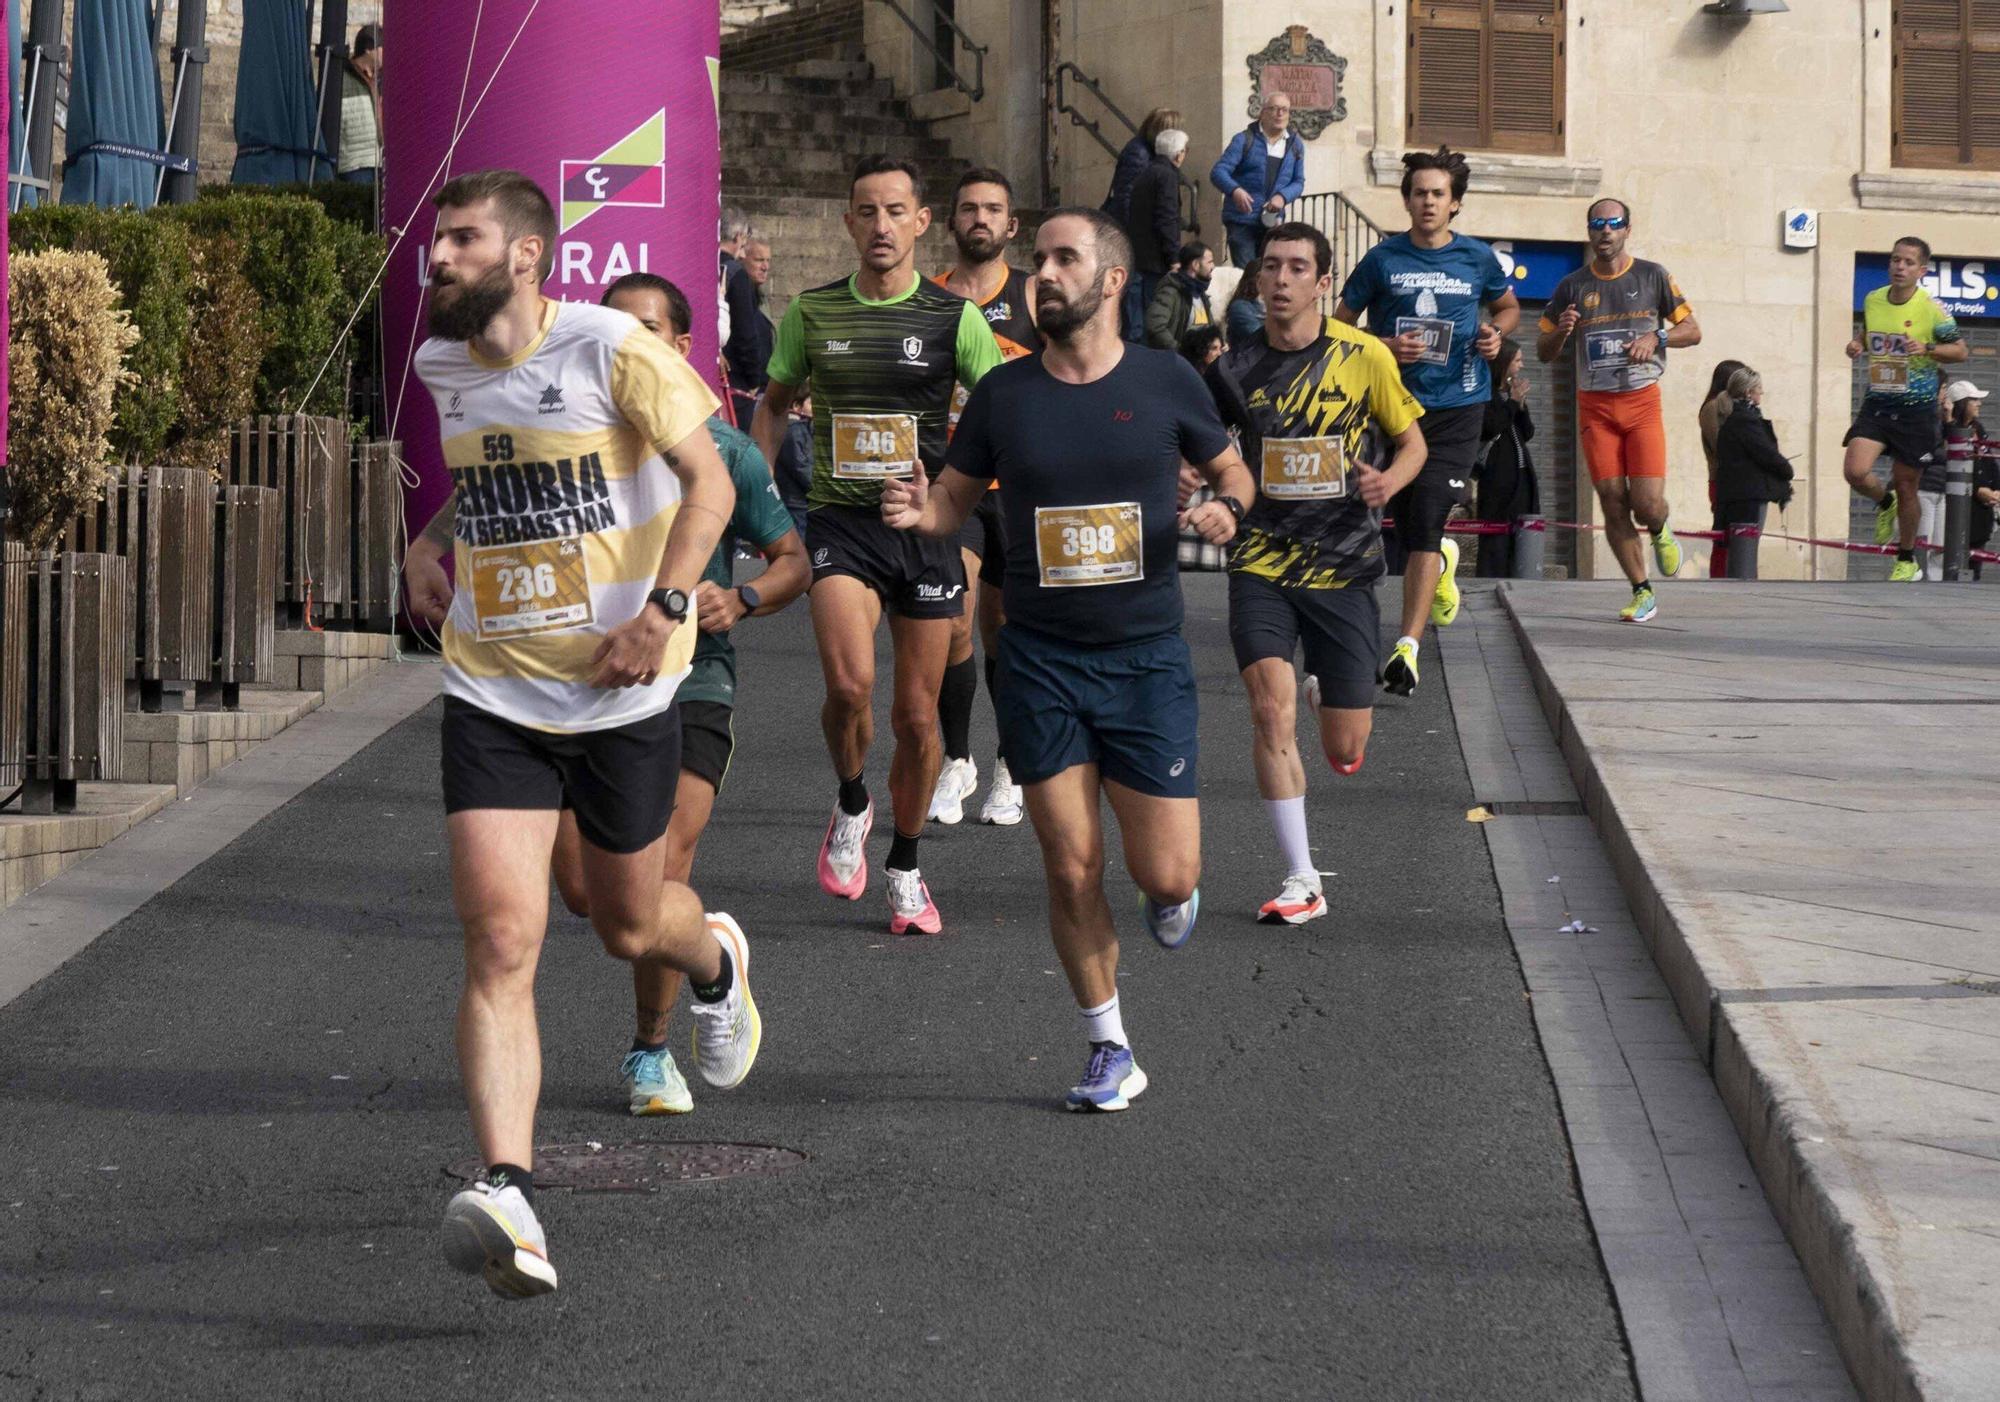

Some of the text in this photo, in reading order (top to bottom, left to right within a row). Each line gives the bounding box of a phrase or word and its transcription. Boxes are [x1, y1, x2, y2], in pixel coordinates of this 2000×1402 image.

[1954, 302, 1986, 315] People
[826, 340, 851, 351] Vital
[483, 434, 515, 462] 59
[854, 431, 896, 455] 446
[1283, 452, 1322, 477] 327
[476, 498, 617, 547] SEBASTIAN
[1061, 525, 1116, 556] 398
[496, 563, 557, 603] 236
[916, 584, 942, 597] Vital
